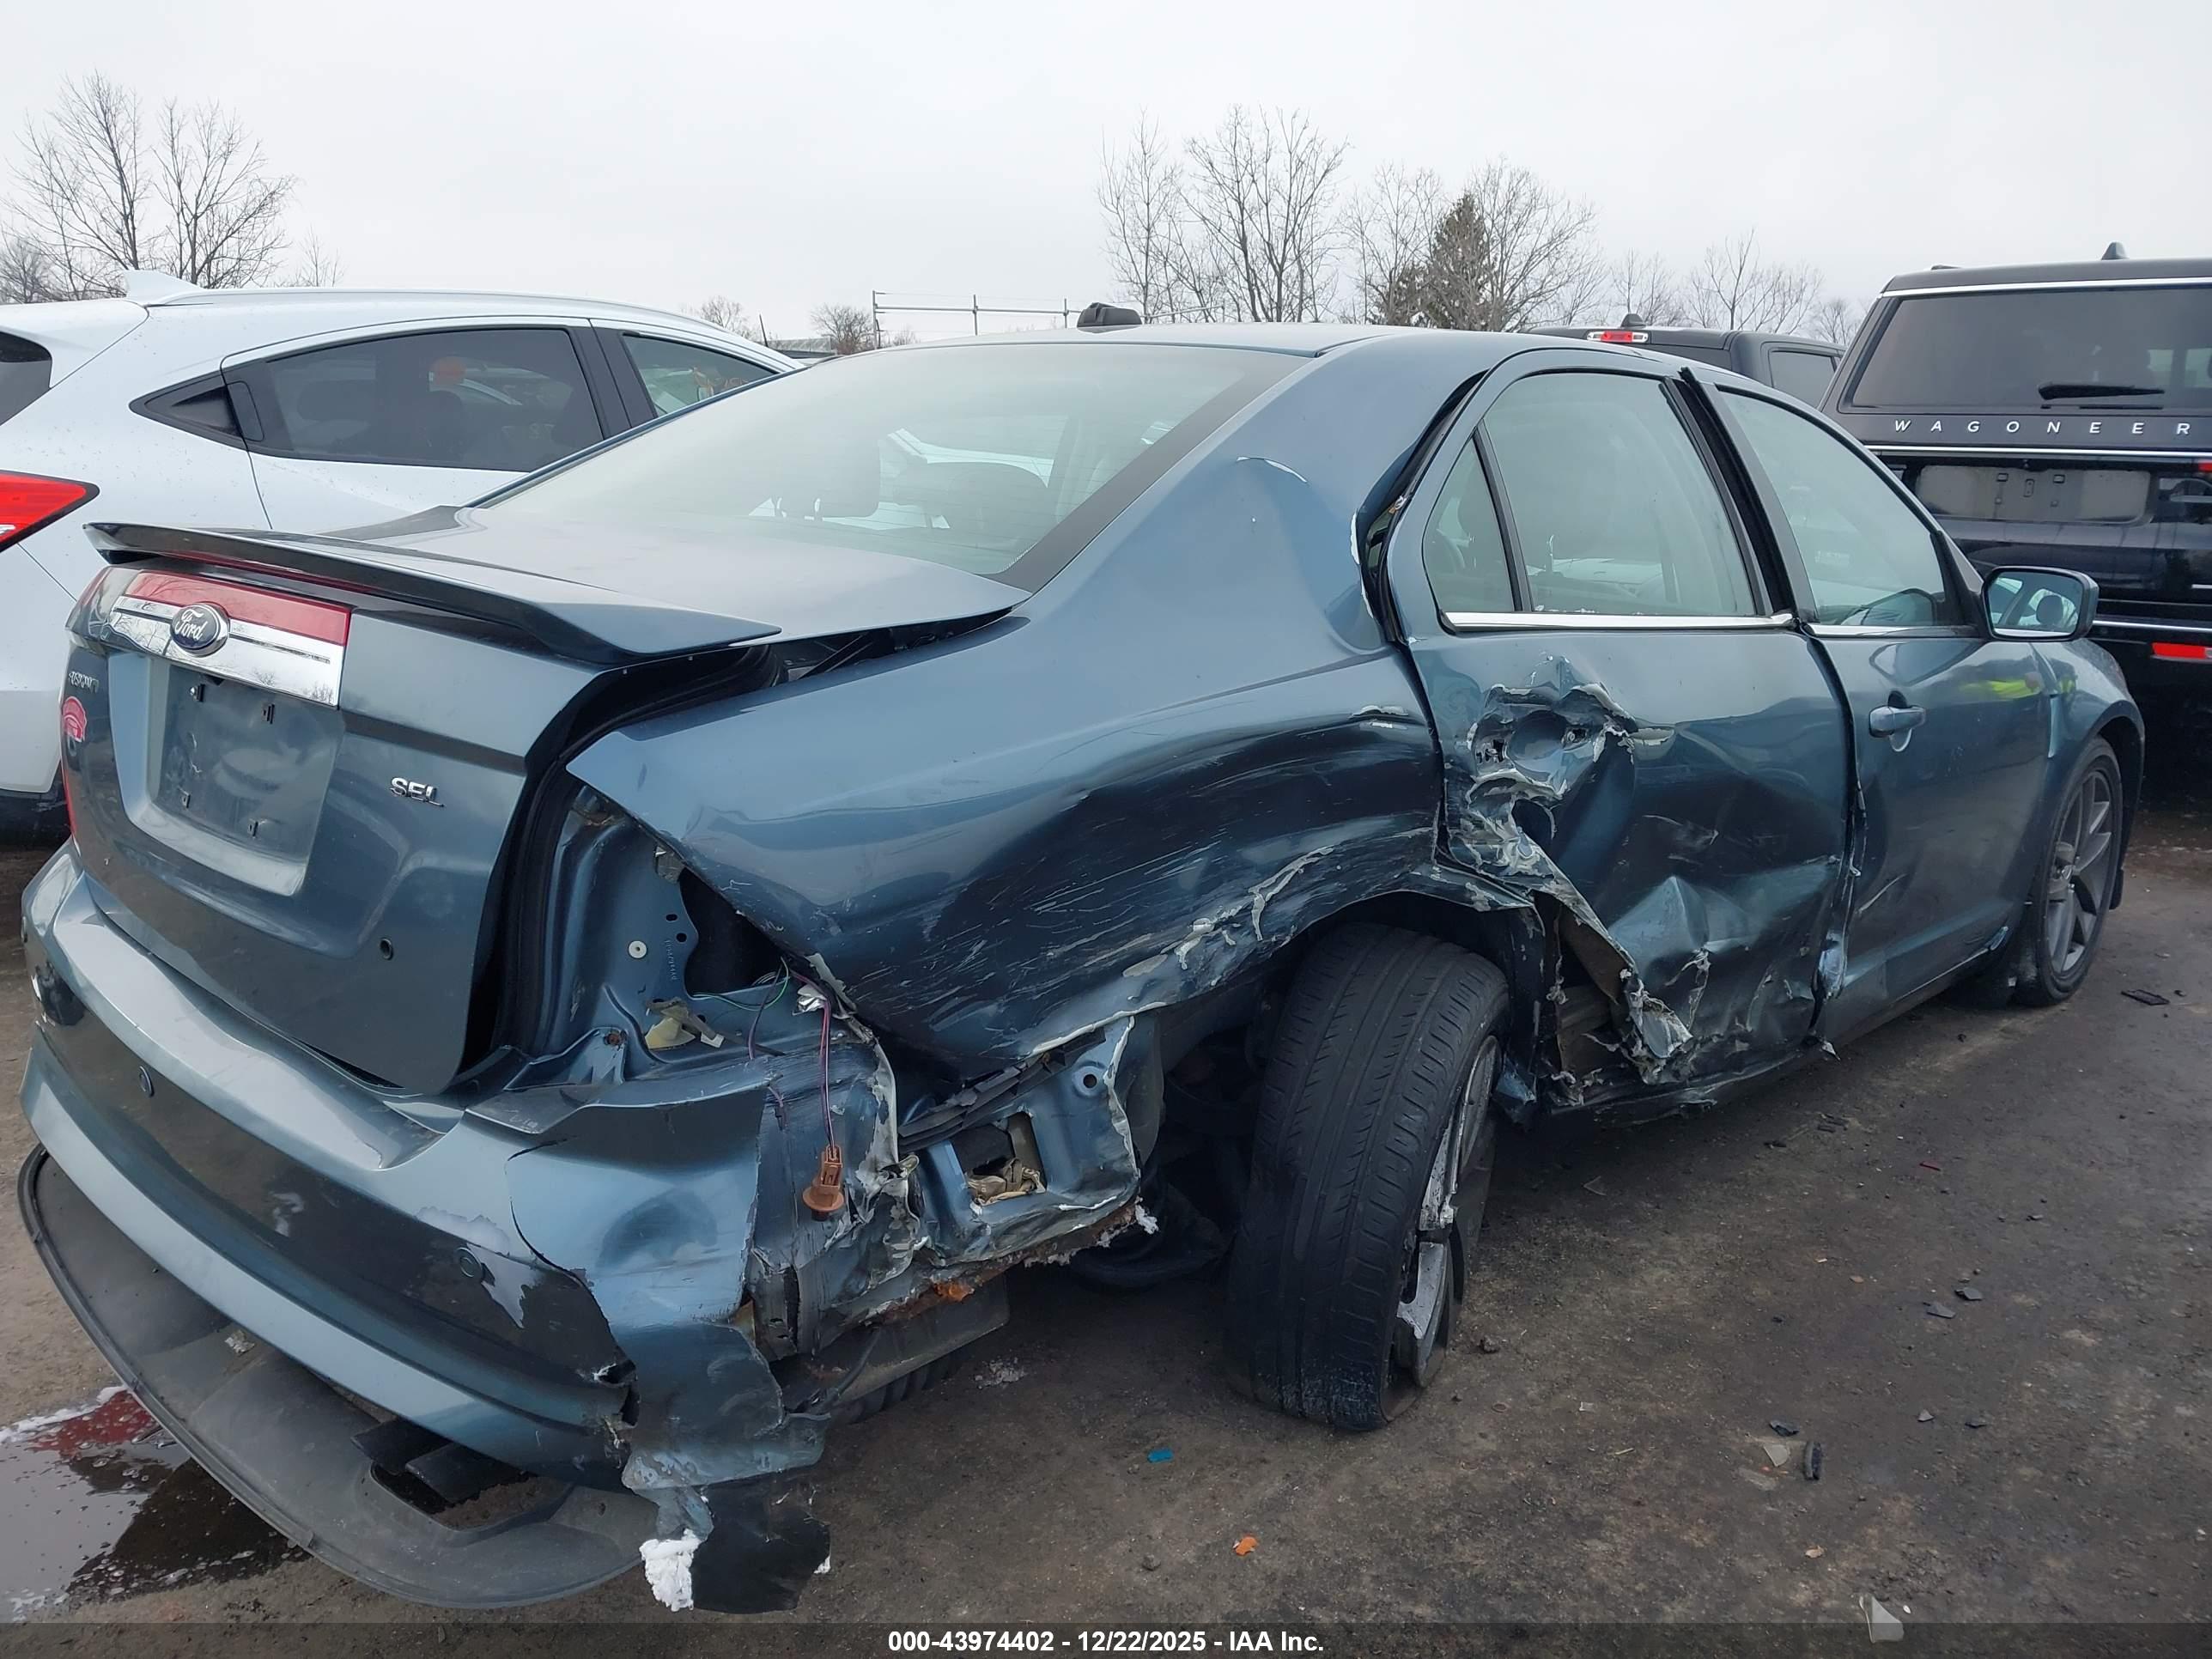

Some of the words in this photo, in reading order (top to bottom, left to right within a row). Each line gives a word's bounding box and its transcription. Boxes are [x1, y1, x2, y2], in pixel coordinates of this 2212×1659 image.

[1894, 420, 2191, 435] WAGONEER
[174, 608, 208, 641] Ford
[390, 777, 441, 805] SEL
